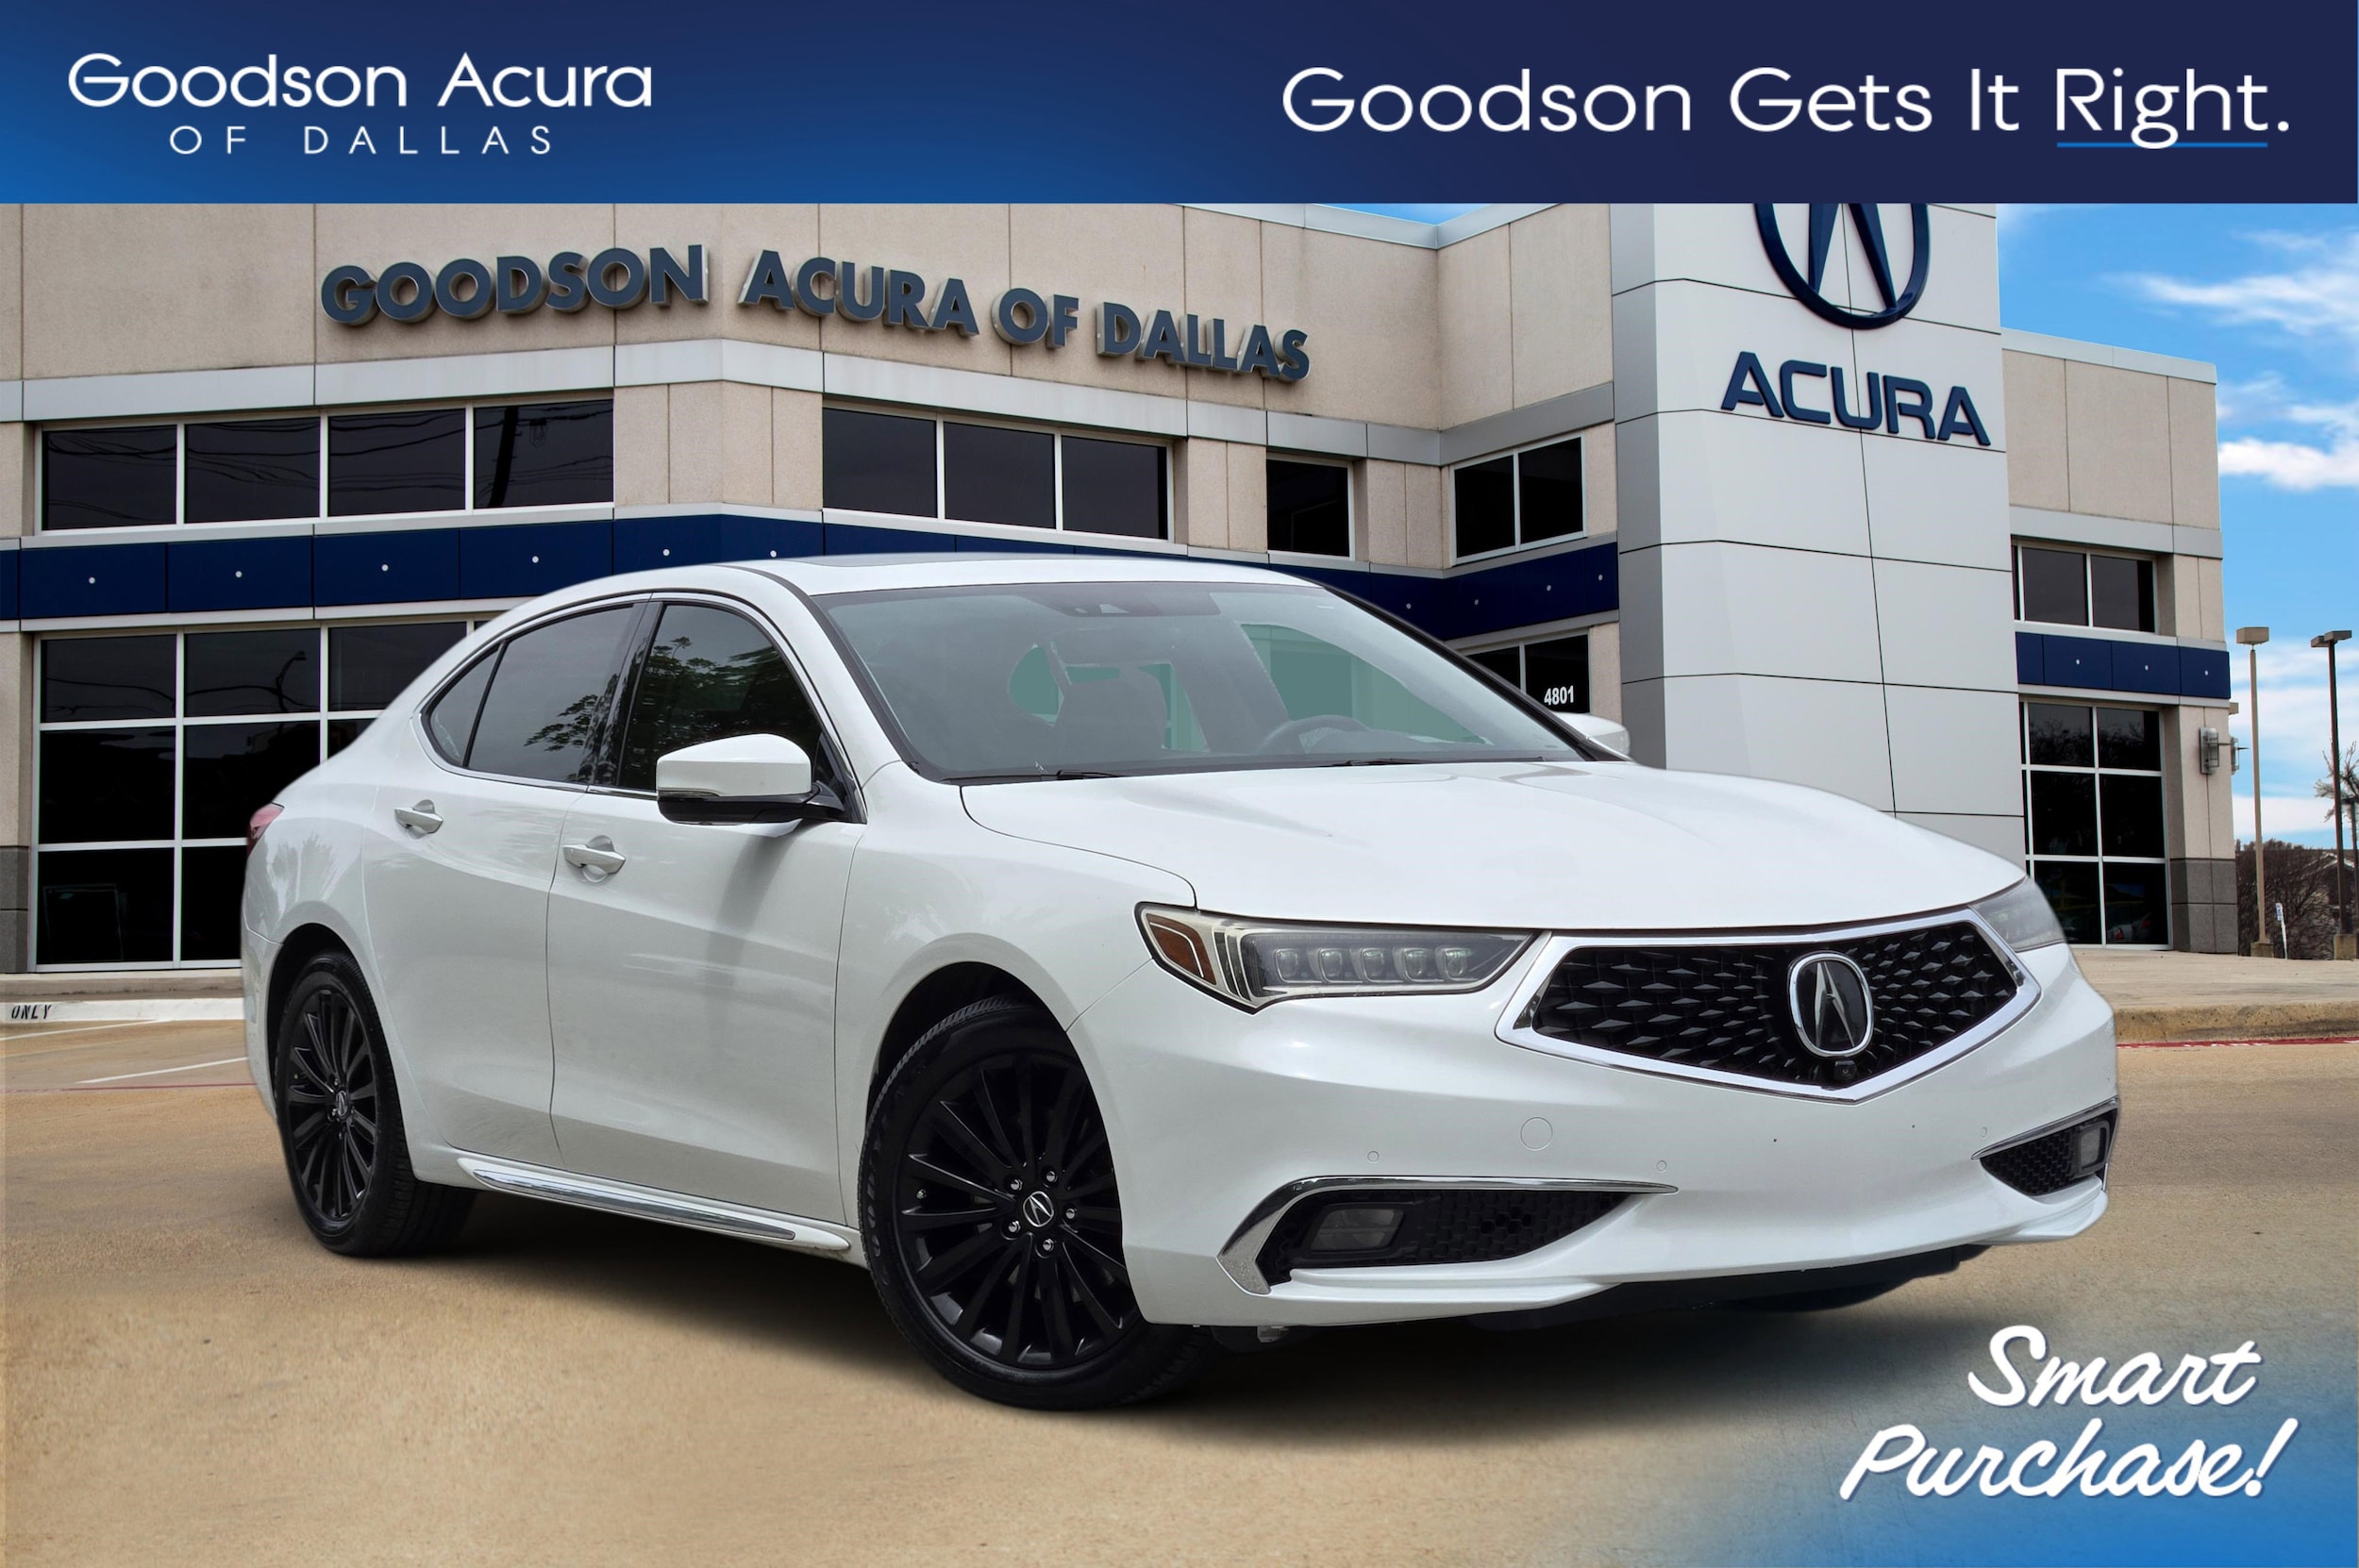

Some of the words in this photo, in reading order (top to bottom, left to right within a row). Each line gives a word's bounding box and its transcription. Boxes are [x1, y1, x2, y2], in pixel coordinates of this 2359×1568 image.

[321, 244, 709, 326] GOODSON
[738, 249, 979, 336] ACURA
[993, 288, 1079, 348] OF
[1096, 301, 1312, 383] DALLAS
[1721, 350, 1991, 447] ACURA
[1544, 685, 1574, 706] 4801
[11, 1004, 52, 1019] ONLY
